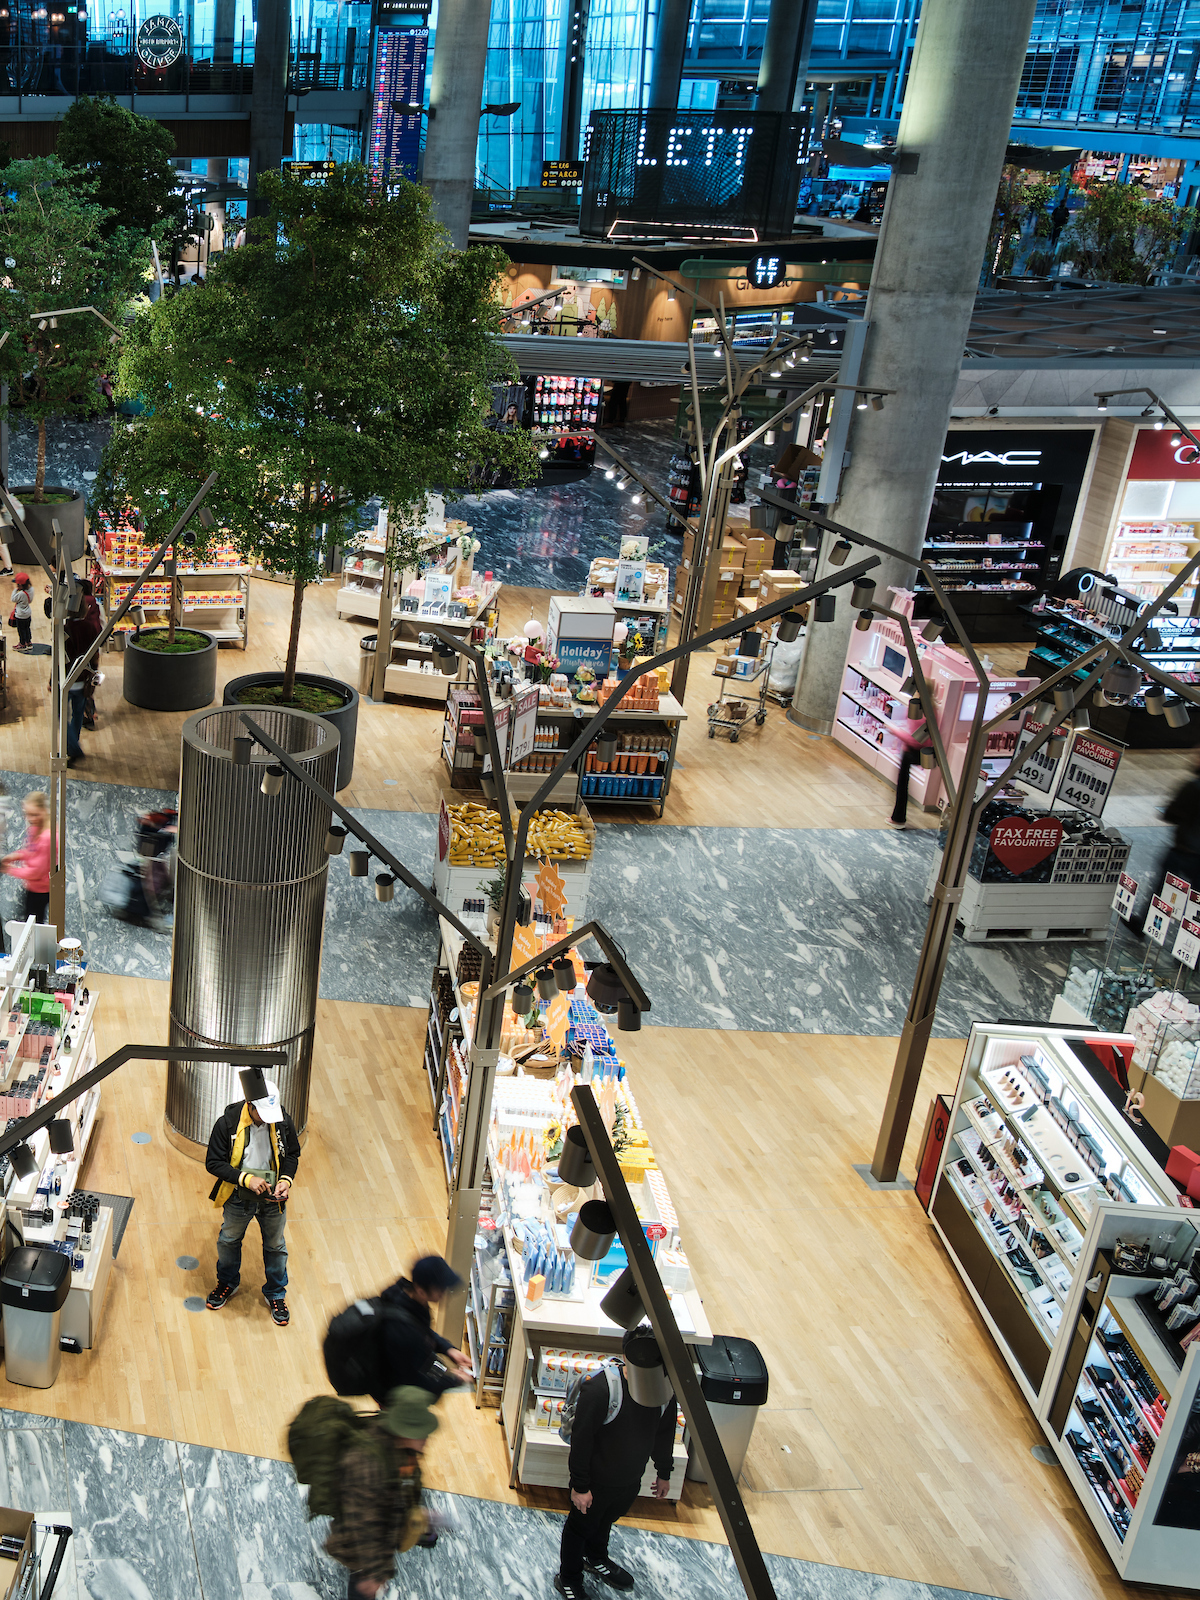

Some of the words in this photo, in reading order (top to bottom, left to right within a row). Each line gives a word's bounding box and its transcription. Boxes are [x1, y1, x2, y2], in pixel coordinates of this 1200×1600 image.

[144, 17, 176, 33] JAMIE
[140, 49, 178, 66] OLIVER
[637, 128, 754, 165] LETT
[561, 646, 603, 660] Holiday
[518, 694, 537, 714] SALE
[1075, 745, 1115, 768] FAVOURITE
[1081, 739, 1097, 751] TAX
[1097, 745, 1115, 759] FREE
[1065, 787, 1090, 805] 449
[996, 828, 1024, 838] TAX
[1025, 828, 1058, 839] FREE
[993, 838, 1055, 847] FAVOURITES
[1147, 926, 1159, 938] 618
[1177, 949, 1190, 961] 418
